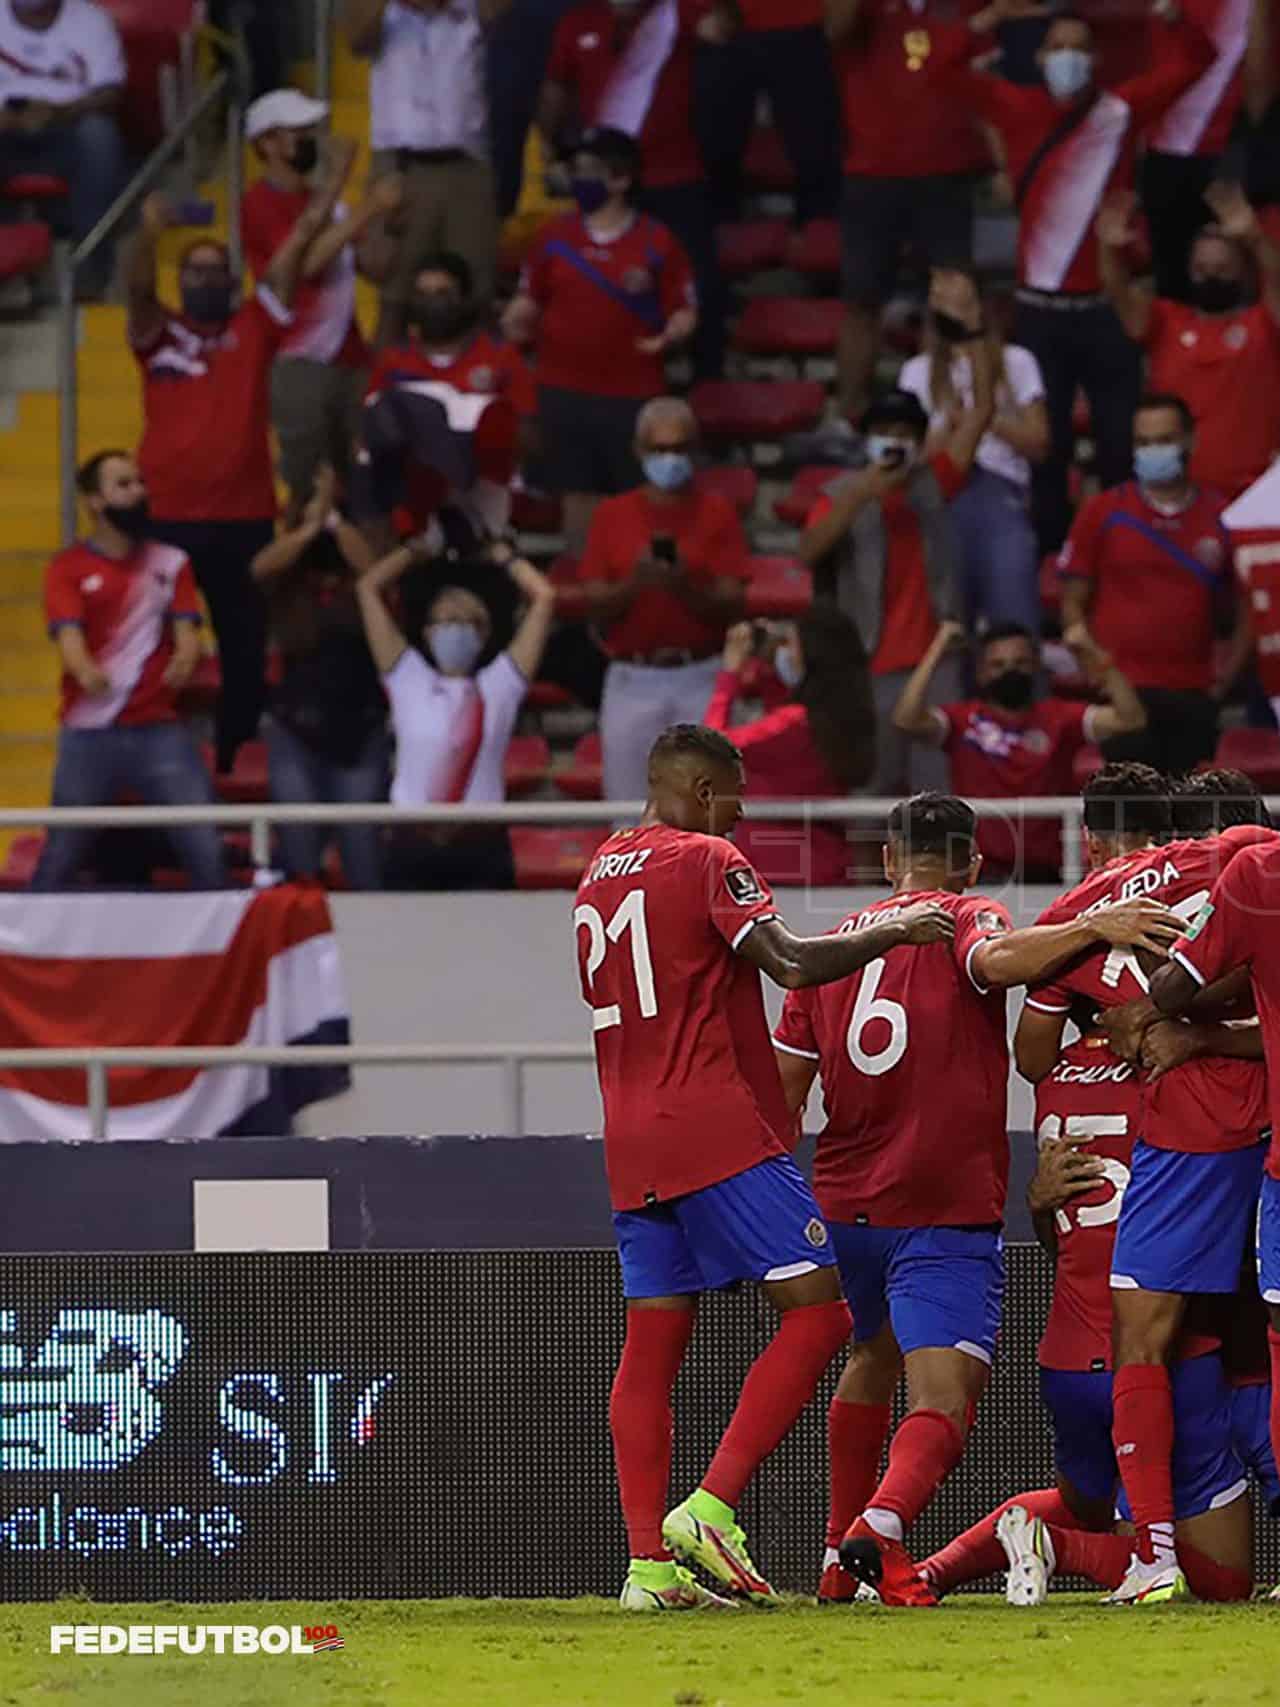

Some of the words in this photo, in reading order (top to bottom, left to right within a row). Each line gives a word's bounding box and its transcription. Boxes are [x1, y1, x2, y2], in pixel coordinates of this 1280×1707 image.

[573, 889, 658, 1031] 21
[847, 956, 908, 1076] 6
[0, 1492, 244, 1557] alance
